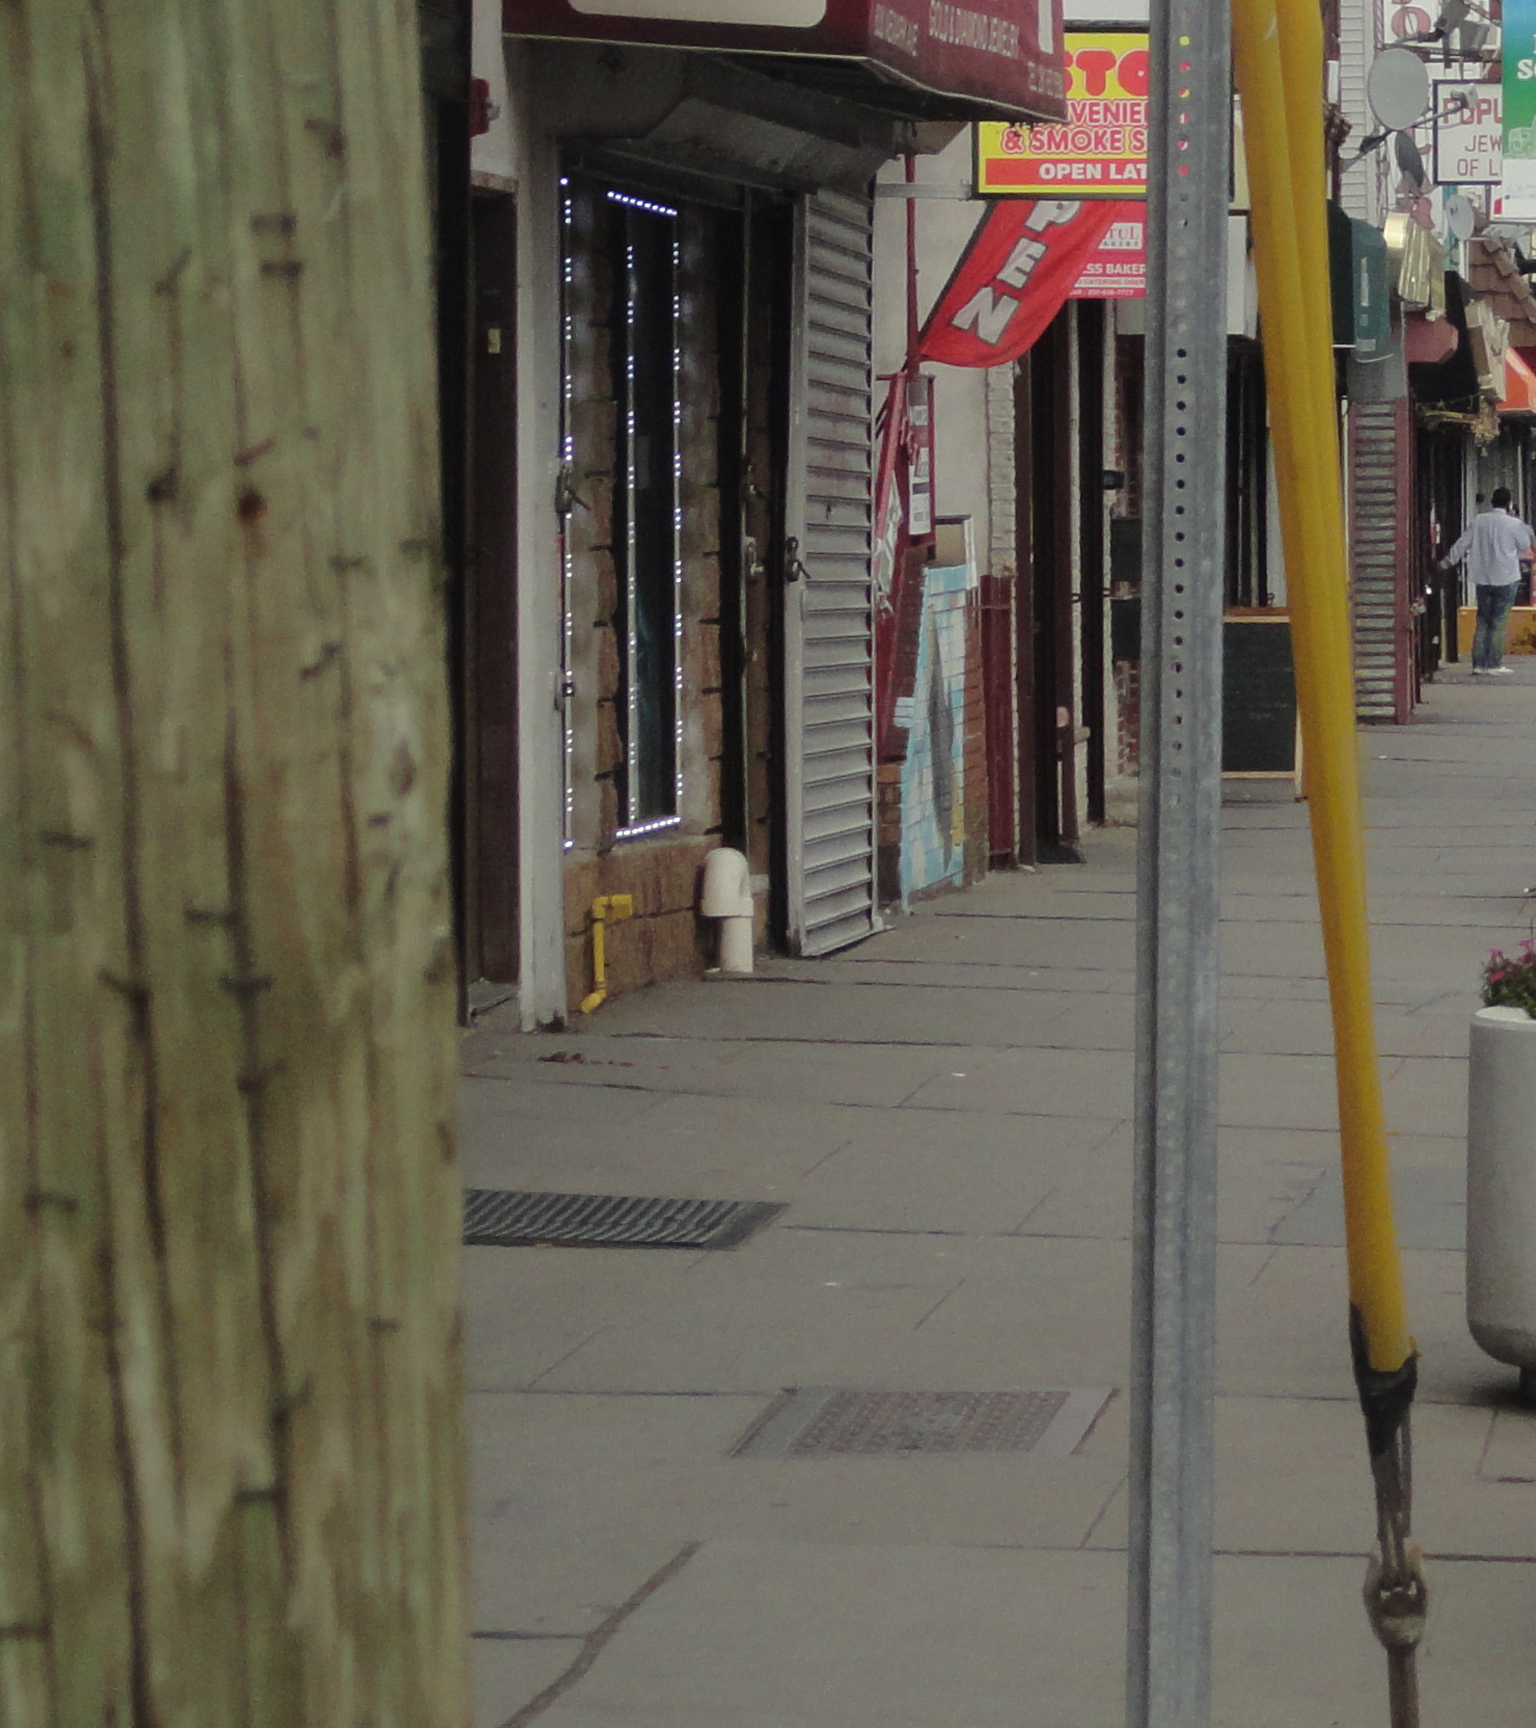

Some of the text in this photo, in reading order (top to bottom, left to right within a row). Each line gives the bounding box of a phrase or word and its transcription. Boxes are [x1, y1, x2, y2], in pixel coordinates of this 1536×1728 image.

[1031, 129, 1122, 152] SMOKE
[1039, 163, 1101, 180] OPEN
[1457, 158, 1478, 176] OF
